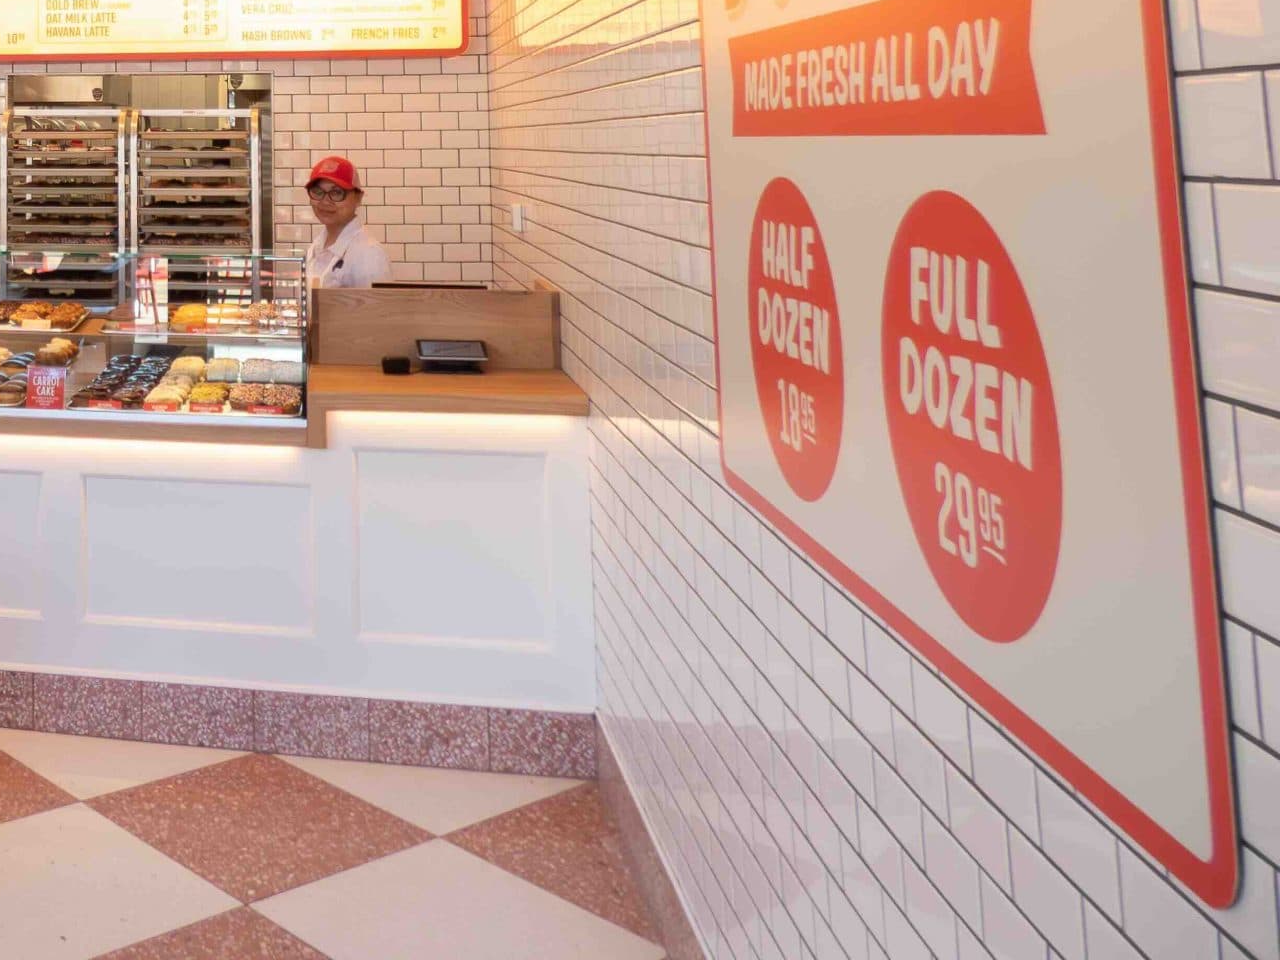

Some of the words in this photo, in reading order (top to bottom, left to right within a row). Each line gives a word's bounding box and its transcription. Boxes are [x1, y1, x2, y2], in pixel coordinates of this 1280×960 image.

[45, 0, 70, 11] COLD
[72, 0, 100, 10] BREW
[45, 12, 62, 24] OAT
[65, 12, 88, 24] MILK
[91, 11, 117, 23] LATTE
[45, 26, 81, 38] HAVANA
[84, 25, 111, 37] LATTE
[241, 30, 266, 41] HASH
[270, 29, 312, 41] BROWNS
[351, 27, 389, 40] FRENCH
[392, 26, 420, 39] FRIES
[743, 52, 793, 114] MADE
[795, 40, 867, 109] FRESH
[870, 30, 924, 106] ALL
[926, 16, 1001, 99] DAY
[761, 219, 816, 290] HALF
[909, 246, 1004, 349] FULL
[757, 287, 831, 376] DOZEN
[32, 375, 60, 387] CARROT
[36, 385, 56, 397] CAKE
[899, 336, 1034, 472] DOZEN
